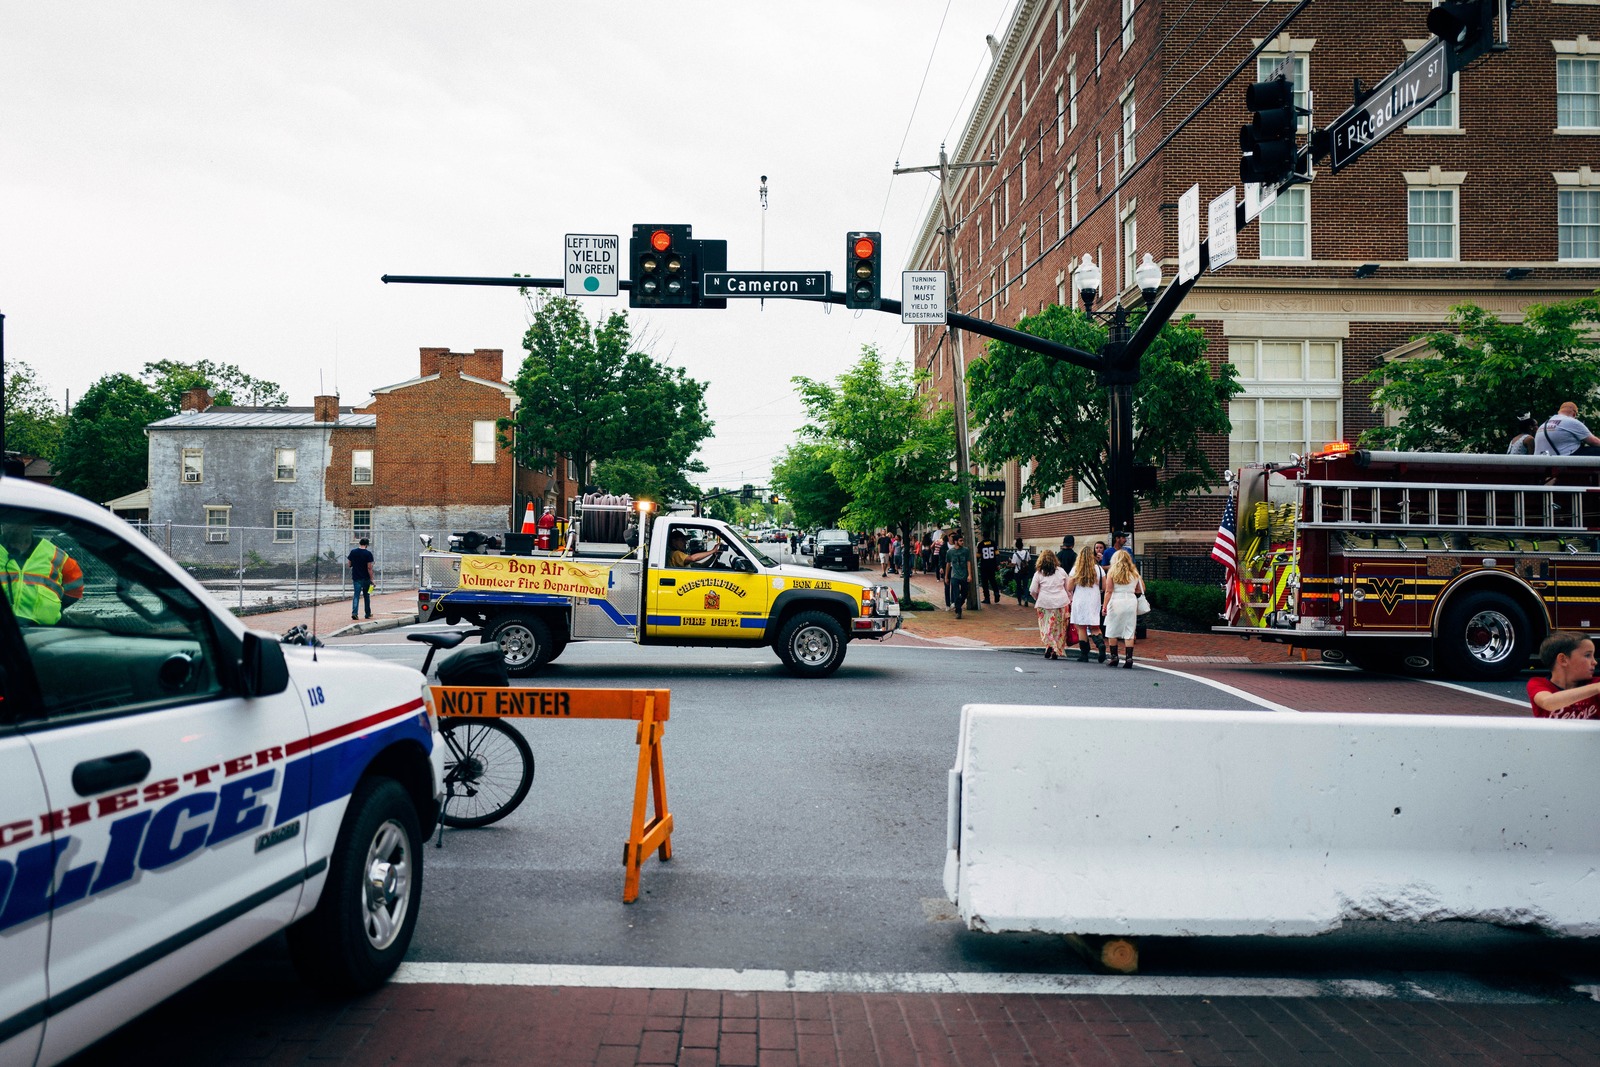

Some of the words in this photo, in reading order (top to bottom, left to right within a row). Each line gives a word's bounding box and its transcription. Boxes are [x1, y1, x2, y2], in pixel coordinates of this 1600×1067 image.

[1338, 134, 1342, 146] E
[1348, 80, 1420, 150] Piccadilly
[1428, 60, 1438, 78] ST
[1216, 222, 1228, 236] MUST
[568, 238, 590, 248] LEFT
[592, 238, 616, 248] TURN
[573, 250, 610, 262] YIELD
[570, 264, 582, 274] ON
[584, 264, 614, 274] GREEN
[727, 278, 798, 292] Cameron
[982, 546, 994, 560] 86
[508, 559, 536, 576] Bon
[540, 561, 564, 576] Air
[462, 574, 515, 588] Volunteer
[518, 578, 540, 589] Fire
[544, 580, 605, 596] Department
[676, 578, 746, 598] CHESTERFIELD
[793, 580, 812, 588] BON
[814, 581, 832, 589] AIR
[682, 617, 706, 626] FIRE
[711, 618, 738, 626] DEPT.
[308, 686, 325, 706] 118
[441, 690, 487, 714] NOT
[495, 691, 570, 716] ENTER
